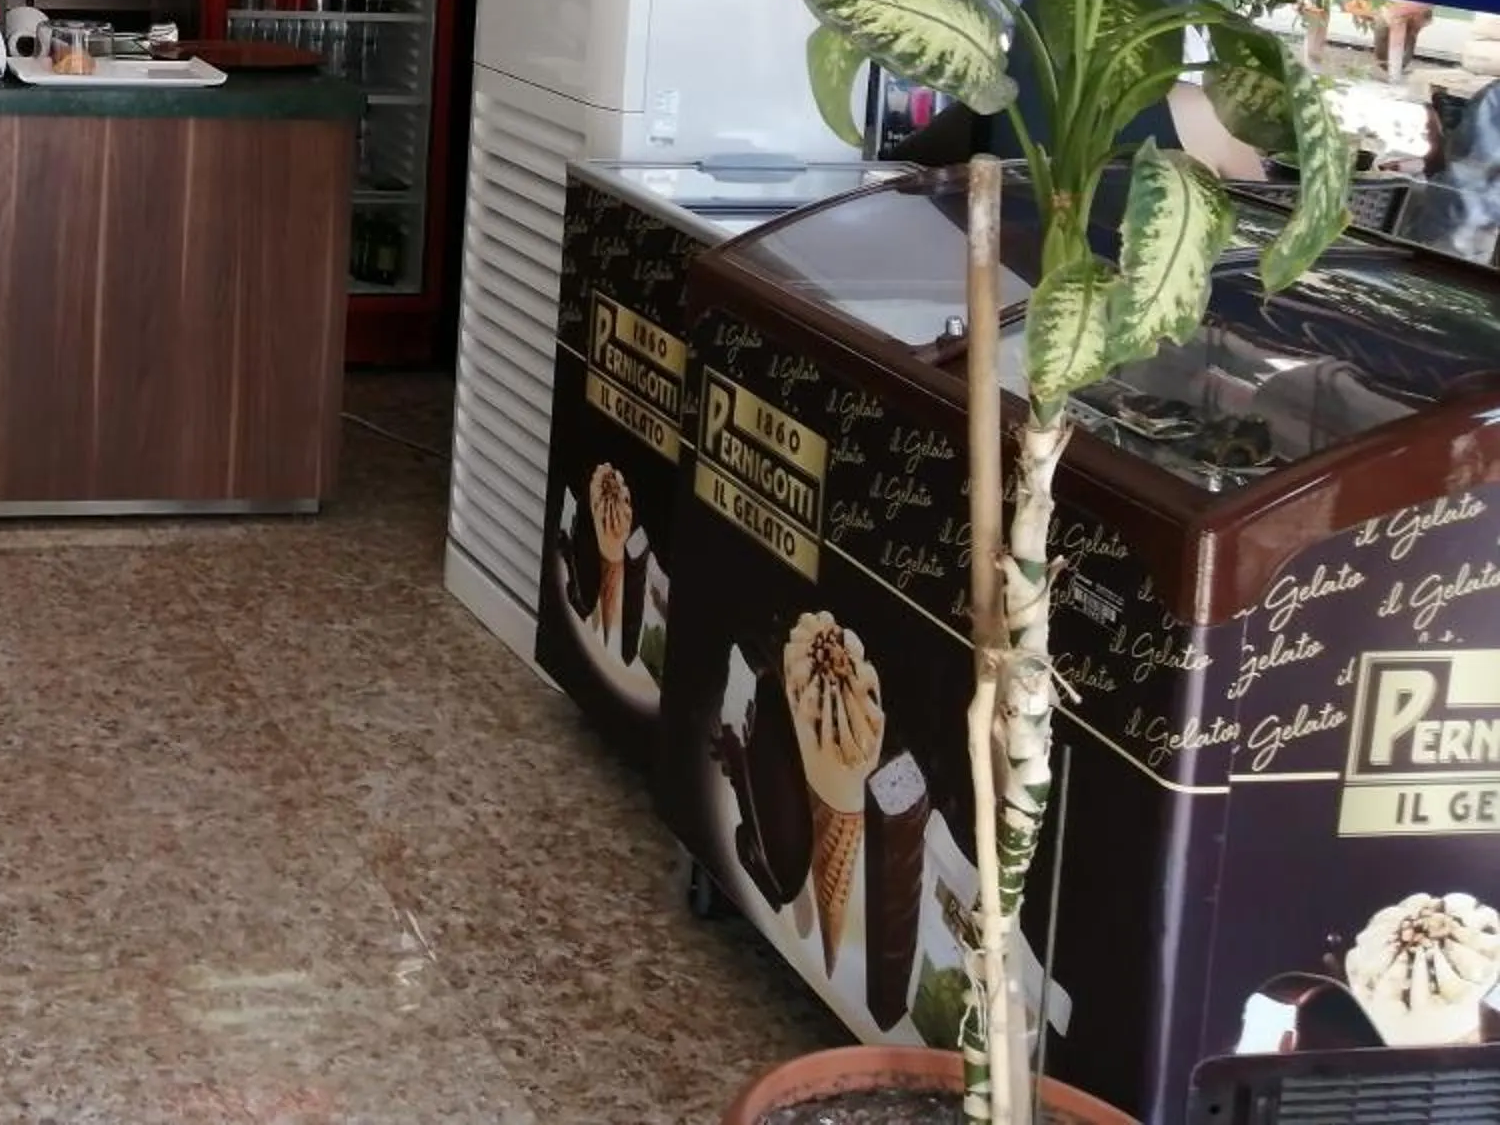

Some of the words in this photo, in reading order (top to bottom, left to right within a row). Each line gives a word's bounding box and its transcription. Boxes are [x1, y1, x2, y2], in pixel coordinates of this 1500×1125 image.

[594, 303, 678, 415] PERNIGOTTI
[615, 396, 664, 446] GELATO
[705, 382, 813, 525] PERNIGOTTI
[757, 407, 801, 453] 1860
[714, 478, 727, 509] IL
[733, 493, 796, 557] GELATO
[1355, 518, 1379, 547] il
[1387, 492, 1488, 561] Gelato
[1264, 562, 1366, 633] Gelato
[1378, 580, 1404, 618] il
[1132, 632, 1213, 683] Gelato
[1248, 703, 1348, 772] Gelato
[1396, 792, 1429, 825] IL
[1449, 790, 1498, 824] GE
